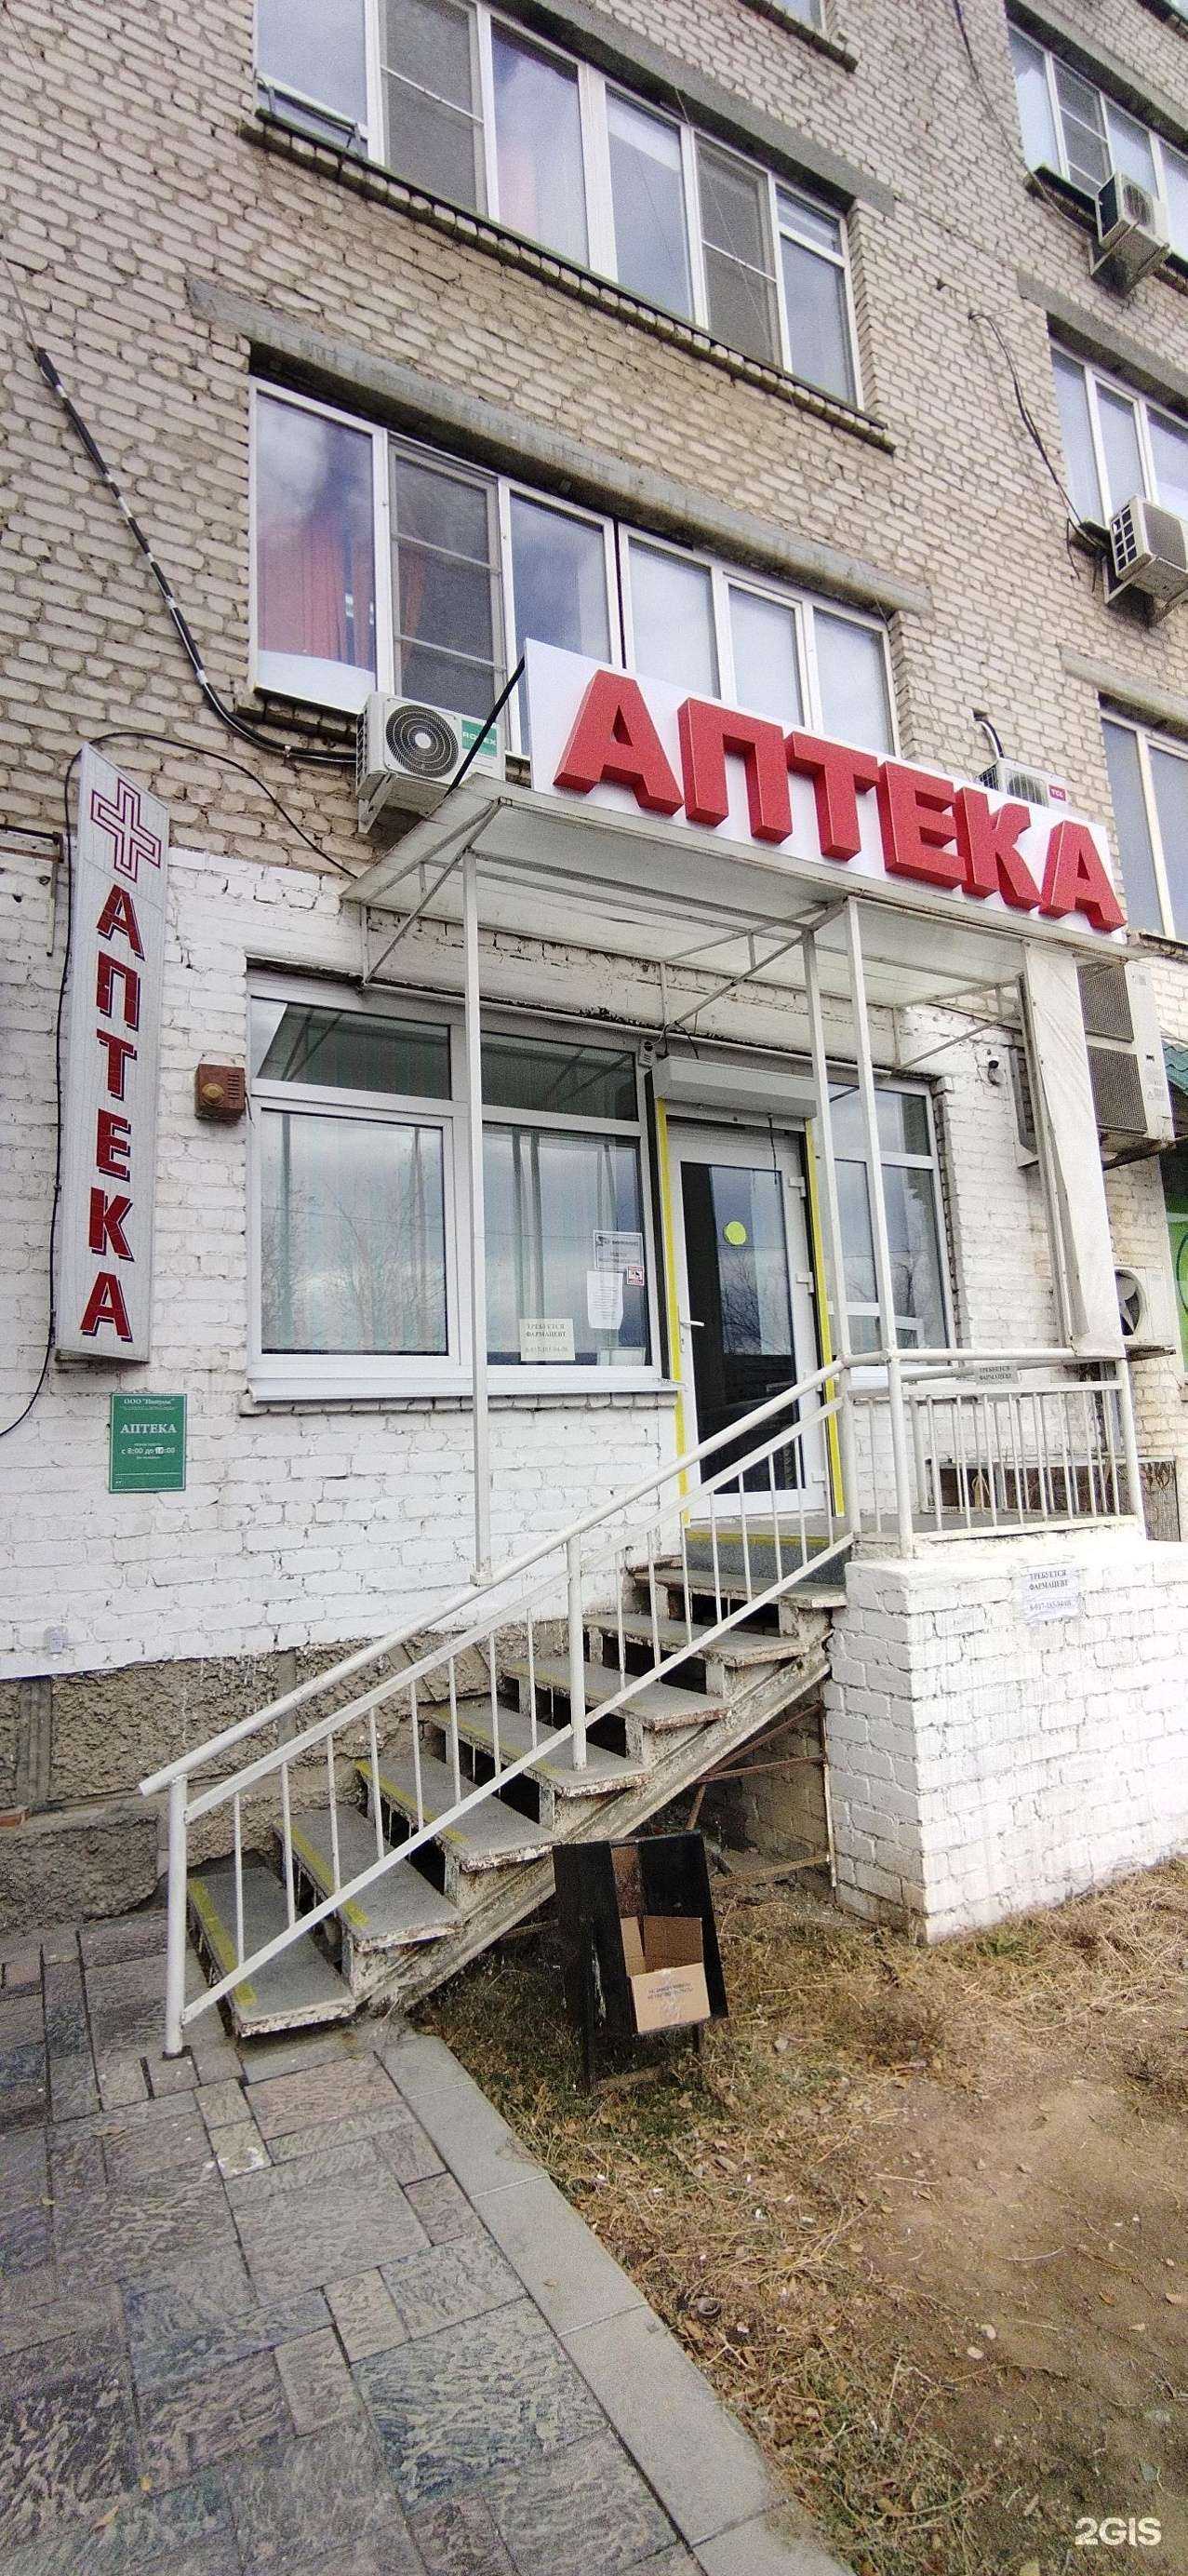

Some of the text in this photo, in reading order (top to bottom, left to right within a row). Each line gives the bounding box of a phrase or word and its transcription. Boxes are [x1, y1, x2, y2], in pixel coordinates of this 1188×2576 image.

[462, 731, 497, 745] ROEX
[554, 669, 1127, 932] АПТЕКА
[1050, 789, 1064, 798] TCL
[80, 884, 146, 1343] АПТЕКА
[120, 1423, 178, 1434] АПТЕКА
